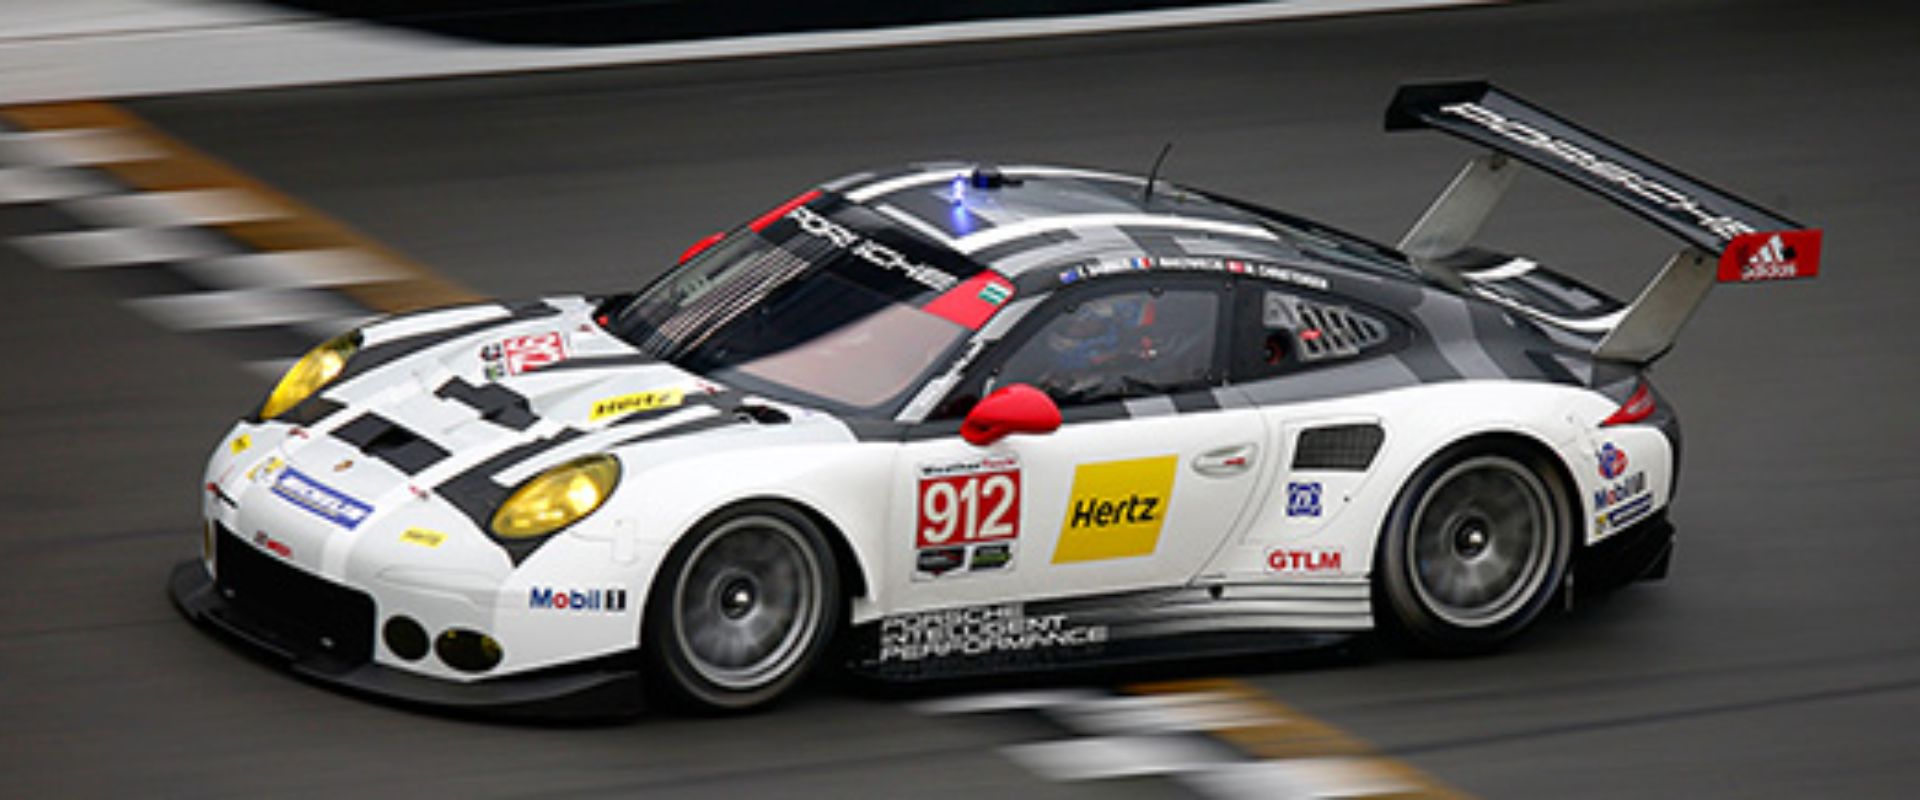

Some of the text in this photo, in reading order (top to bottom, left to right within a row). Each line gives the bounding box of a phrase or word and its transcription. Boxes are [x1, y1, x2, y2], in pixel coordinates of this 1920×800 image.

[1440, 102, 1757, 240] PORSCHE
[1741, 264, 1797, 280] adidas
[923, 475, 1016, 543] 912
[1071, 494, 1160, 528] Hertz
[1267, 550, 1341, 570] GTLM
[528, 586, 601, 610] Mobil
